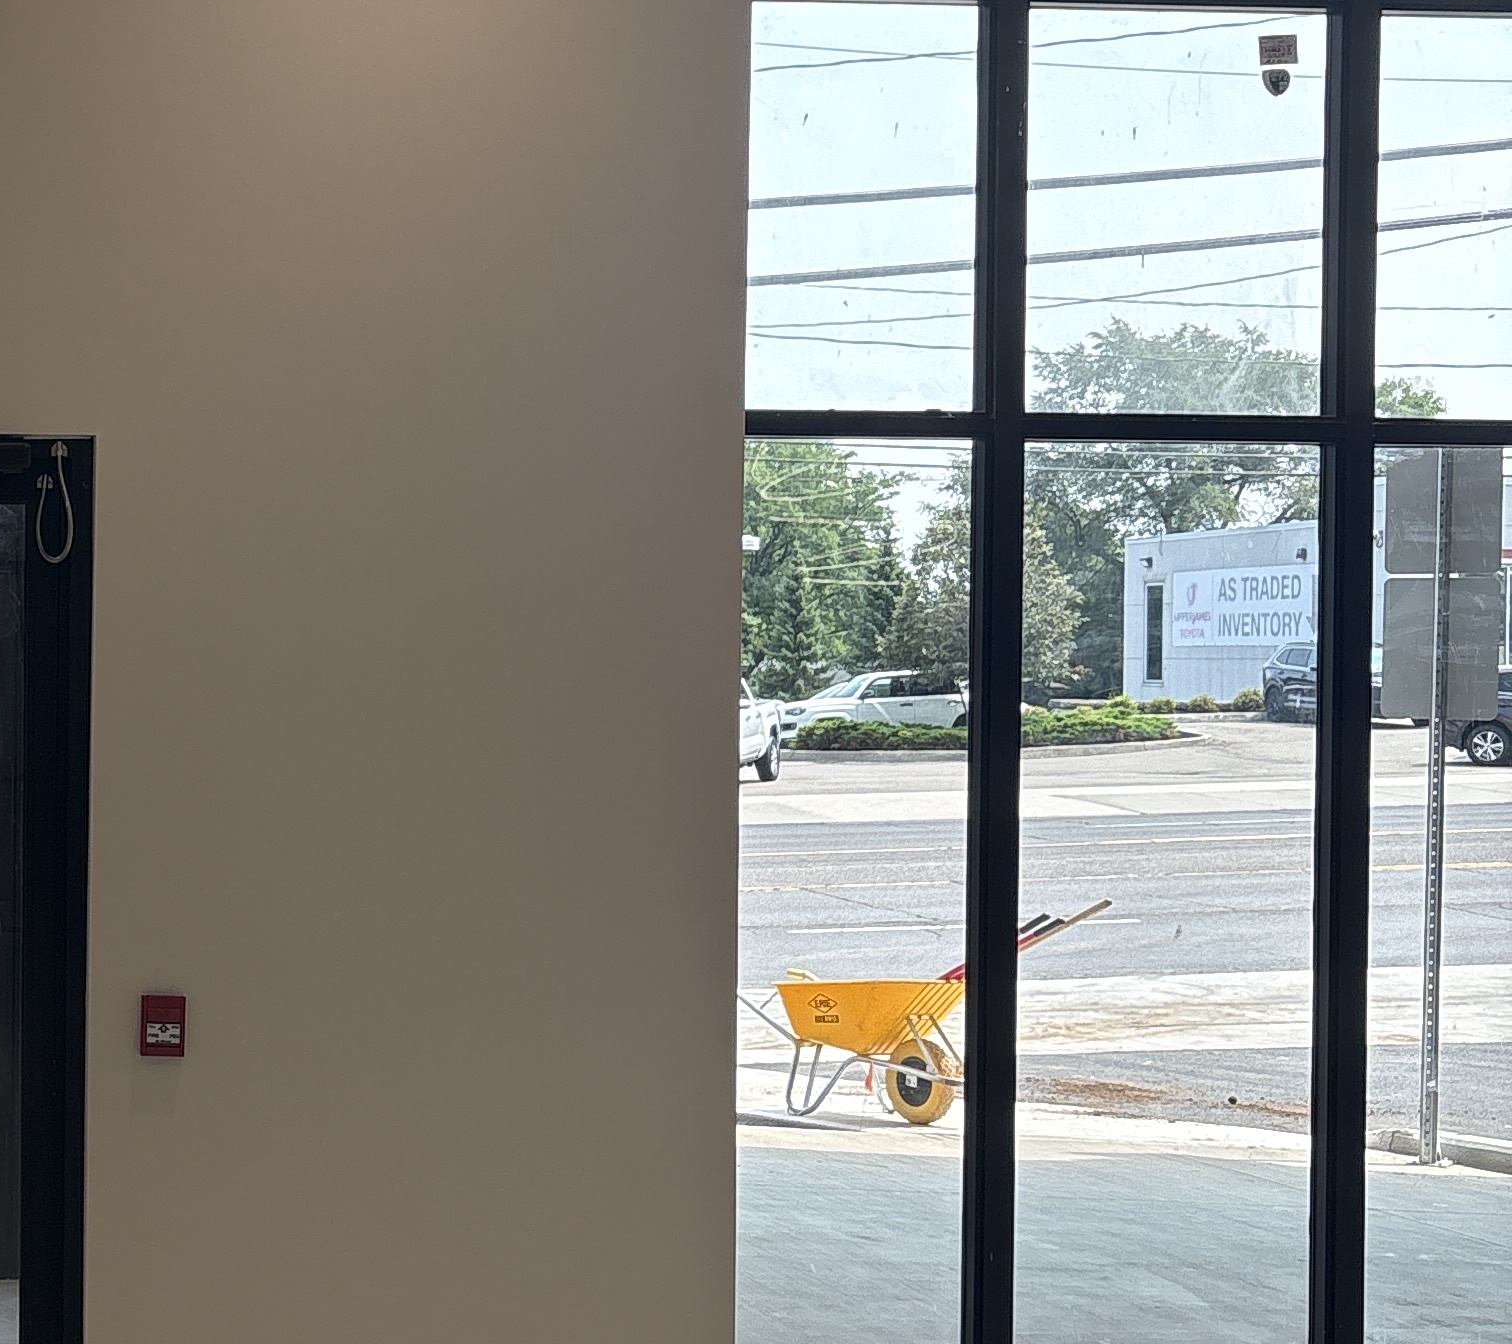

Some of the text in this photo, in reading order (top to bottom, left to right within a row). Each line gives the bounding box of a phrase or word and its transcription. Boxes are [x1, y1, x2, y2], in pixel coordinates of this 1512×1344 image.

[1217, 574, 1302, 602] AS TRADED
[1217, 611, 1303, 637] INVENTORY
